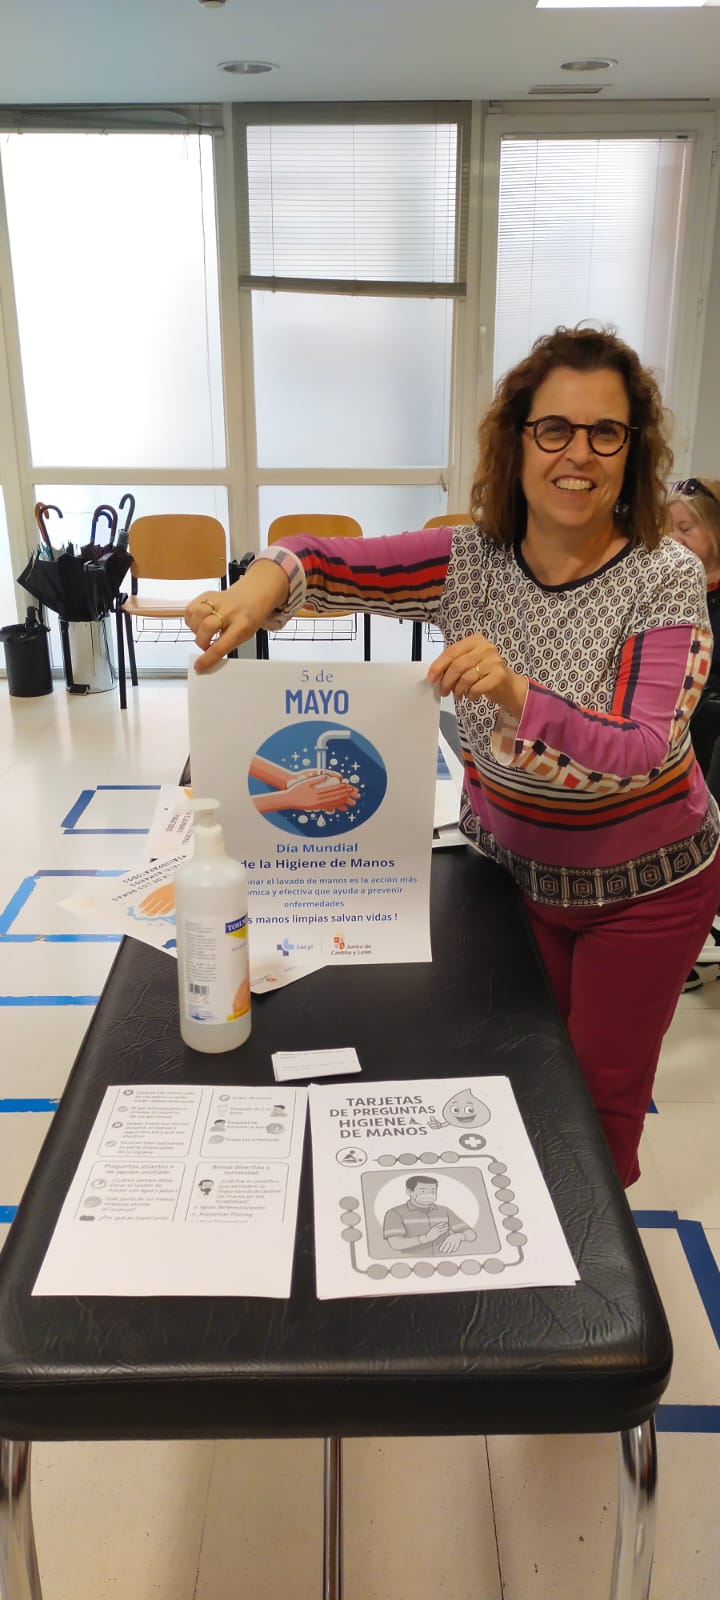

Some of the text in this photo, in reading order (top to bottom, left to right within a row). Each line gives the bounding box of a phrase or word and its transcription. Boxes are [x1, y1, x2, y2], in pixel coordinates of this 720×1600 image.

[301, 669, 334, 683] 5 de
[285, 689, 349, 714] MAYO
[276, 843, 358, 853] Día Mundial
[259, 858, 271, 869] la
[275, 858, 326, 871] Higiene
[330, 858, 346, 868] de
[350, 858, 395, 868] Manos
[276, 877, 304, 885] lavado
[306, 877, 317, 885] de
[370, 876, 398, 884] acción
[272, 889, 277, 897] y
[279, 888, 312, 896] efectiva
[314, 888, 331, 897] que
[333, 887, 358, 896] ayuda
[367, 886, 403, 895] prevenir
[284, 900, 344, 908] enfermedades
[255, 916, 290, 924] manos
[292, 914, 329, 925] limpias
[331, 913, 363, 922] salvan
[366, 912, 392, 921] vidas
[346, 1096, 422, 1106] TARJETAS
[330, 1105, 436, 1118] DE PREGUNTAS
[339, 1117, 405, 1128] HIGIENE
[340, 1126, 428, 1138] DE MANOS
